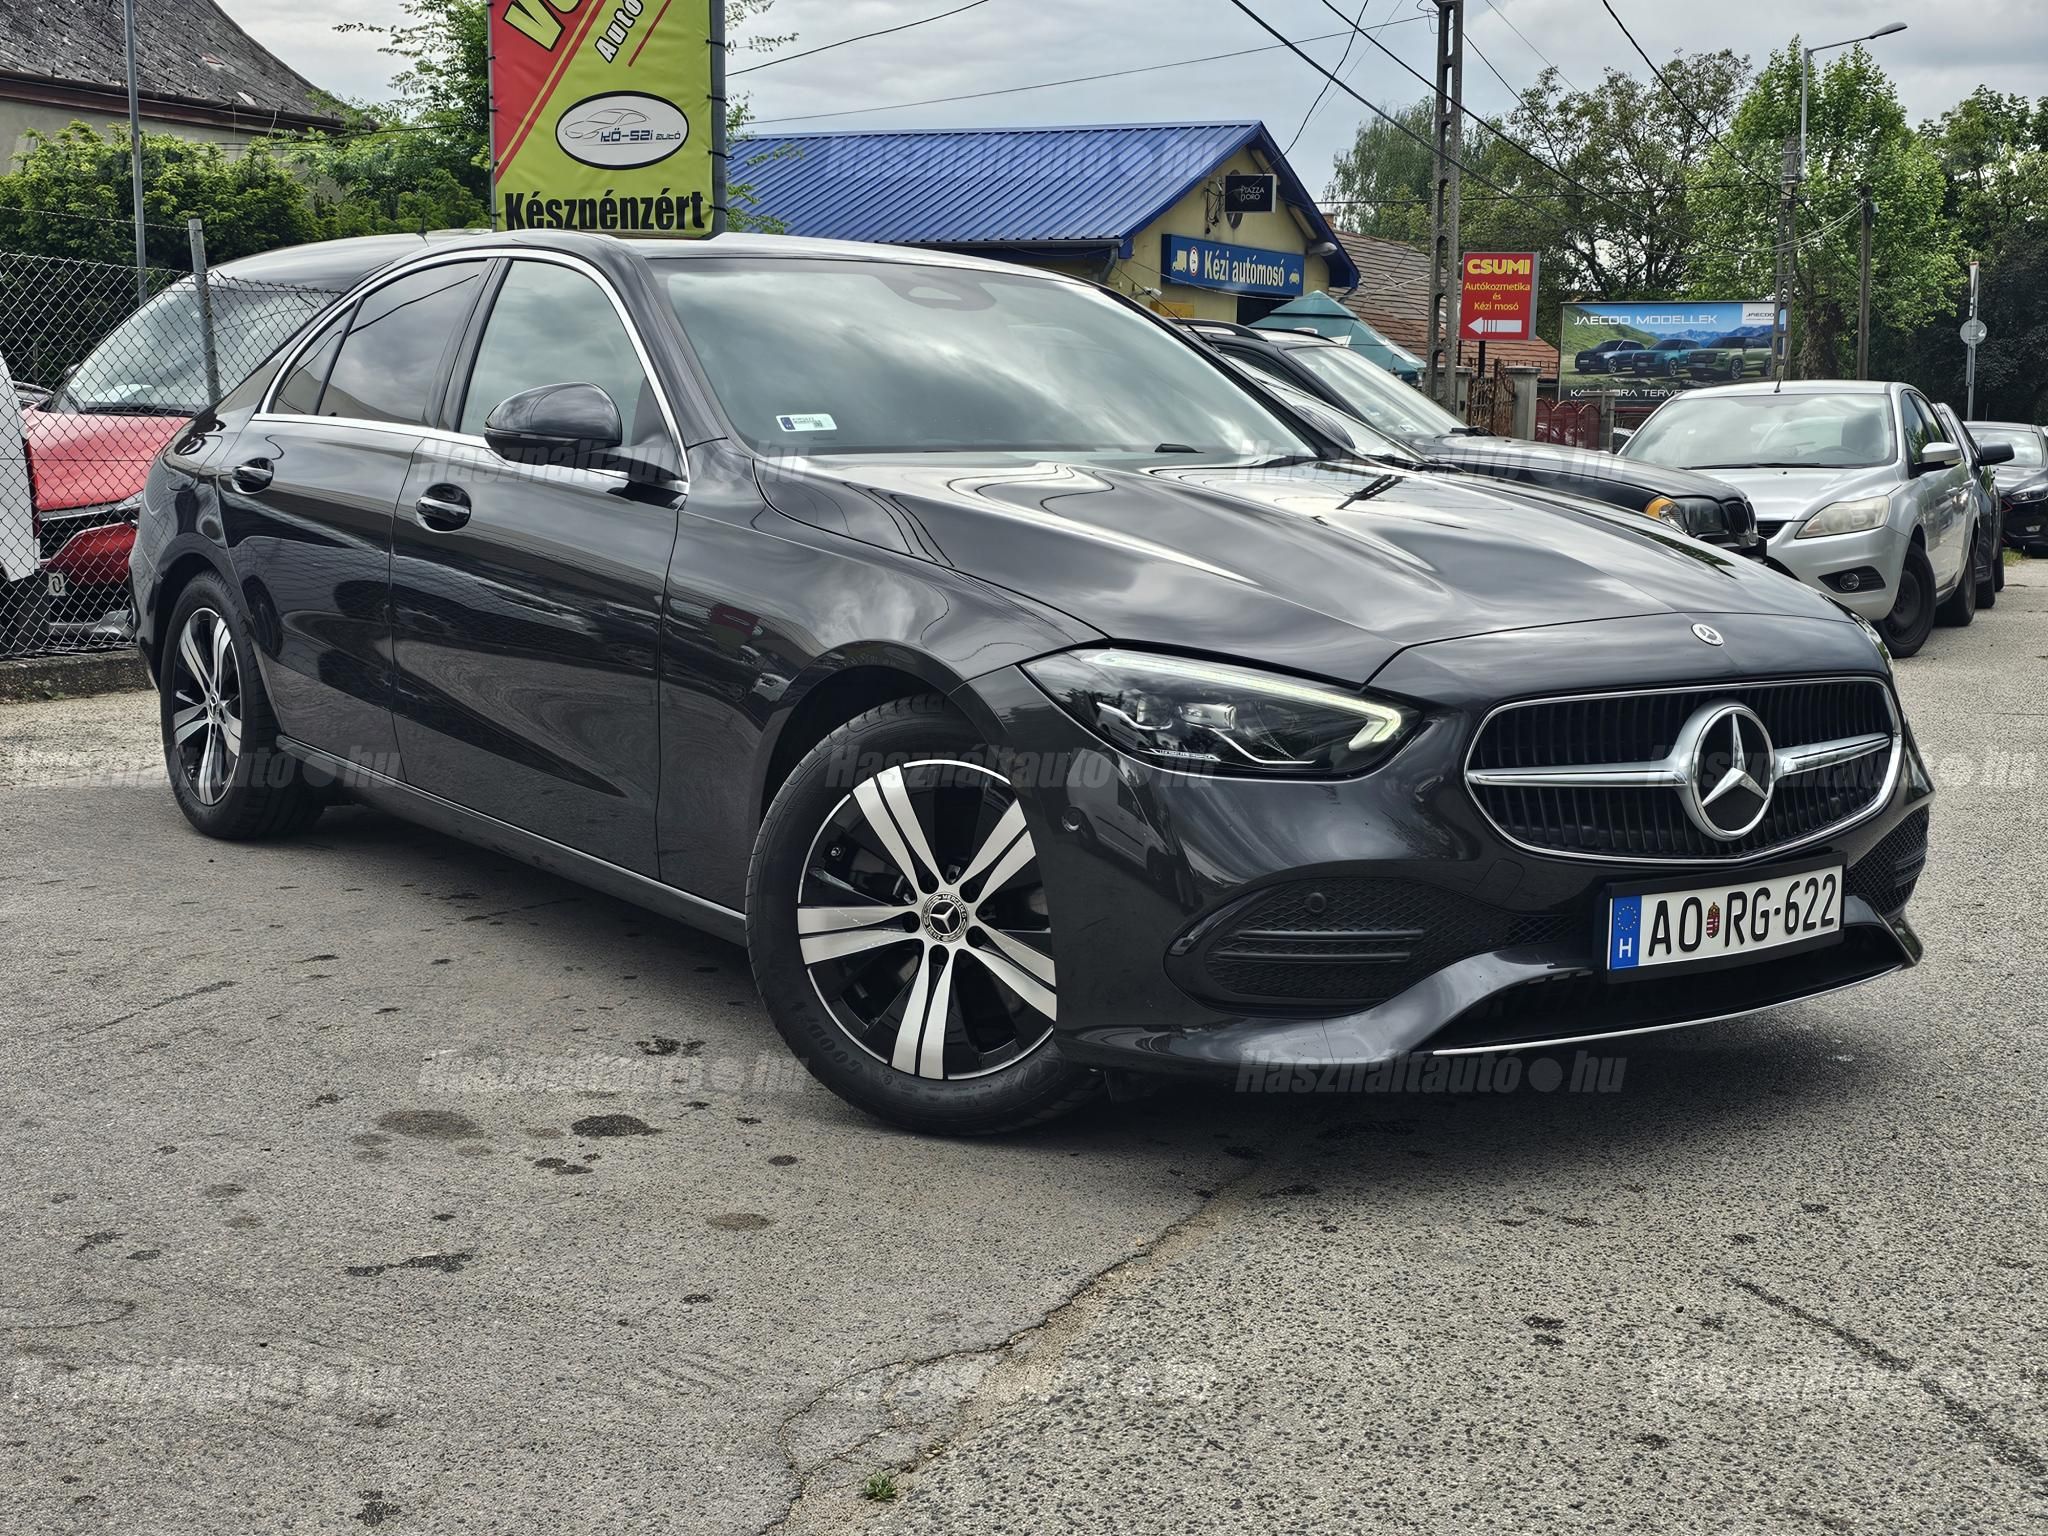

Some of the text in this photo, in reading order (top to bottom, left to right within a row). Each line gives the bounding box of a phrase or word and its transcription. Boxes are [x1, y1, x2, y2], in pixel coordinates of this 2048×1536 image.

[505, 188, 705, 230] Készpénzért
[1204, 250, 1284, 287] Kézi autómosó
[1467, 258, 1531, 275] CSUMI
[1464, 282, 1531, 291] Autókozmetika
[1492, 292, 1501, 300] és
[1474, 301, 1519, 311] Kézi mosó
[1636, 314, 1718, 325] MODELLEK
[1619, 937, 1632, 958] H
